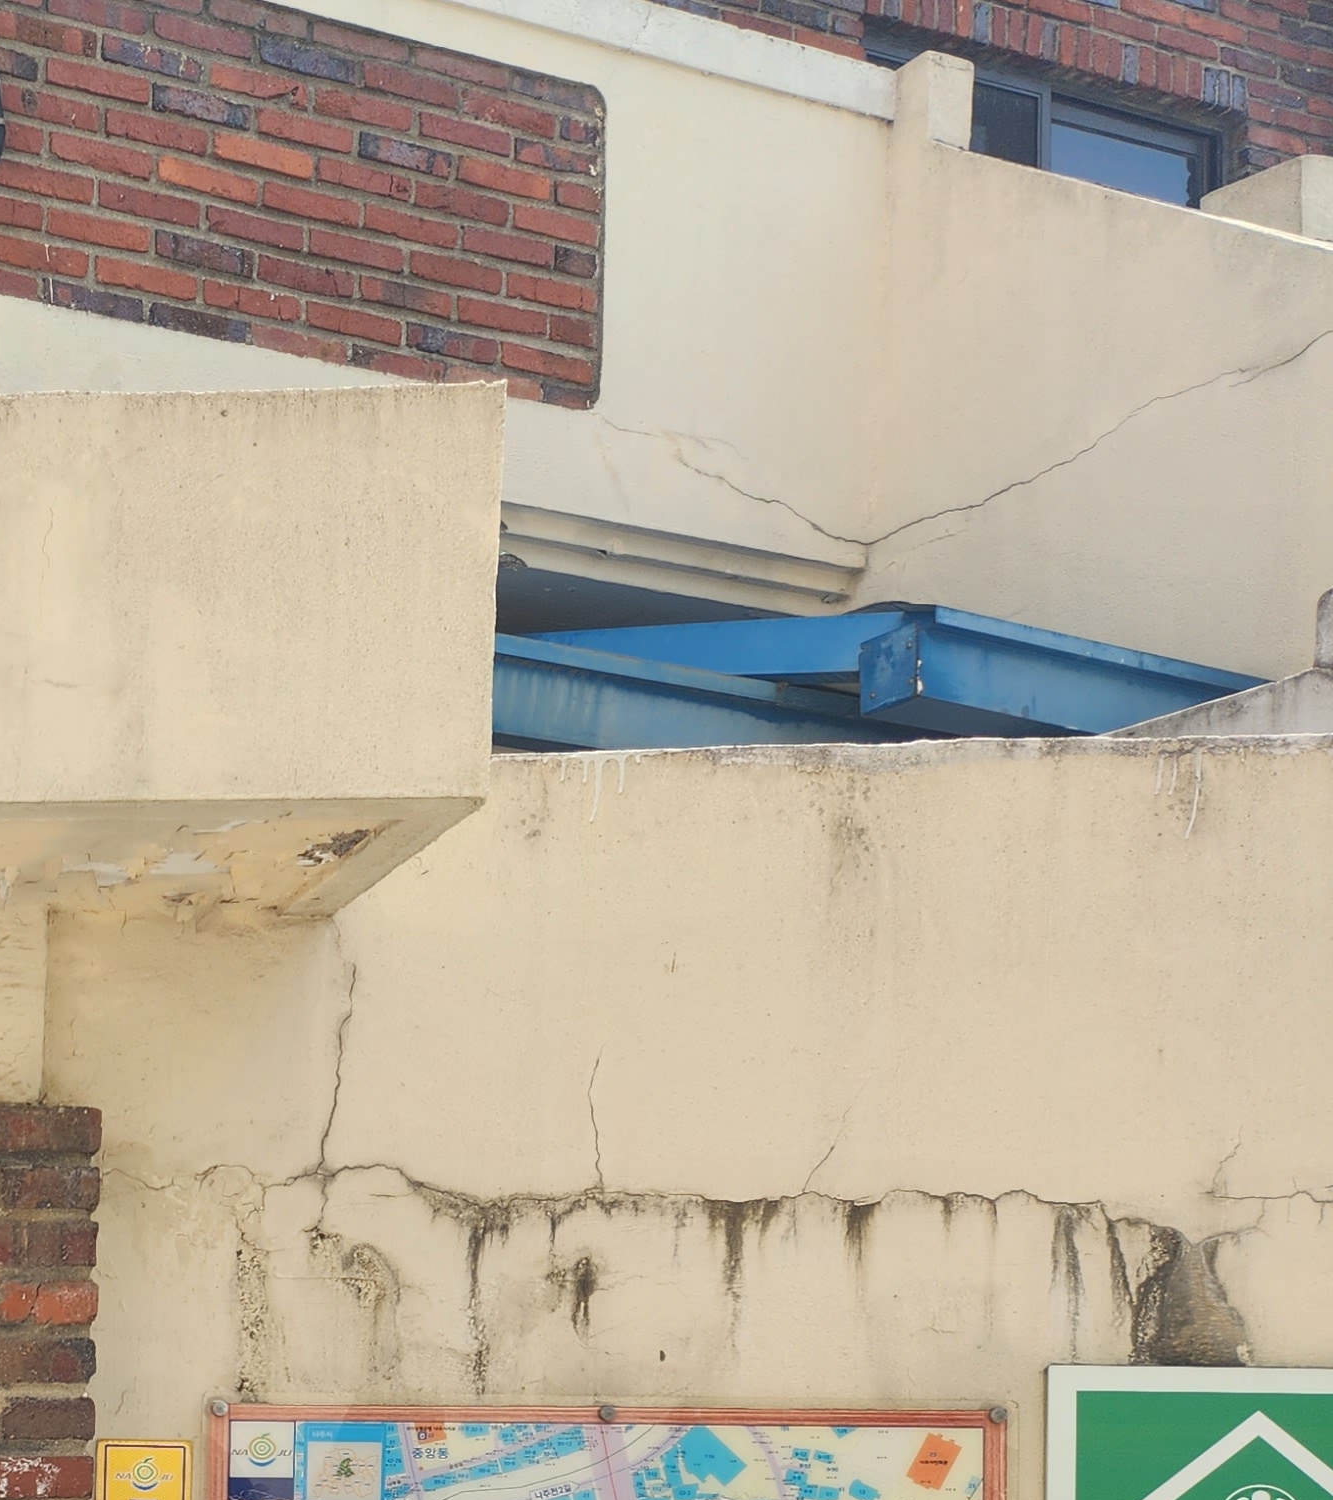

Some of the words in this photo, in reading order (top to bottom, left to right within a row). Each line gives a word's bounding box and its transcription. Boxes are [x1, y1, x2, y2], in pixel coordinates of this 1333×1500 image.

[231, 1449, 249, 1457] NA
[276, 1449, 293, 1457] JU
[412, 1447, 450, 1460] 중앙동
[114, 1472, 131, 1480] NA
